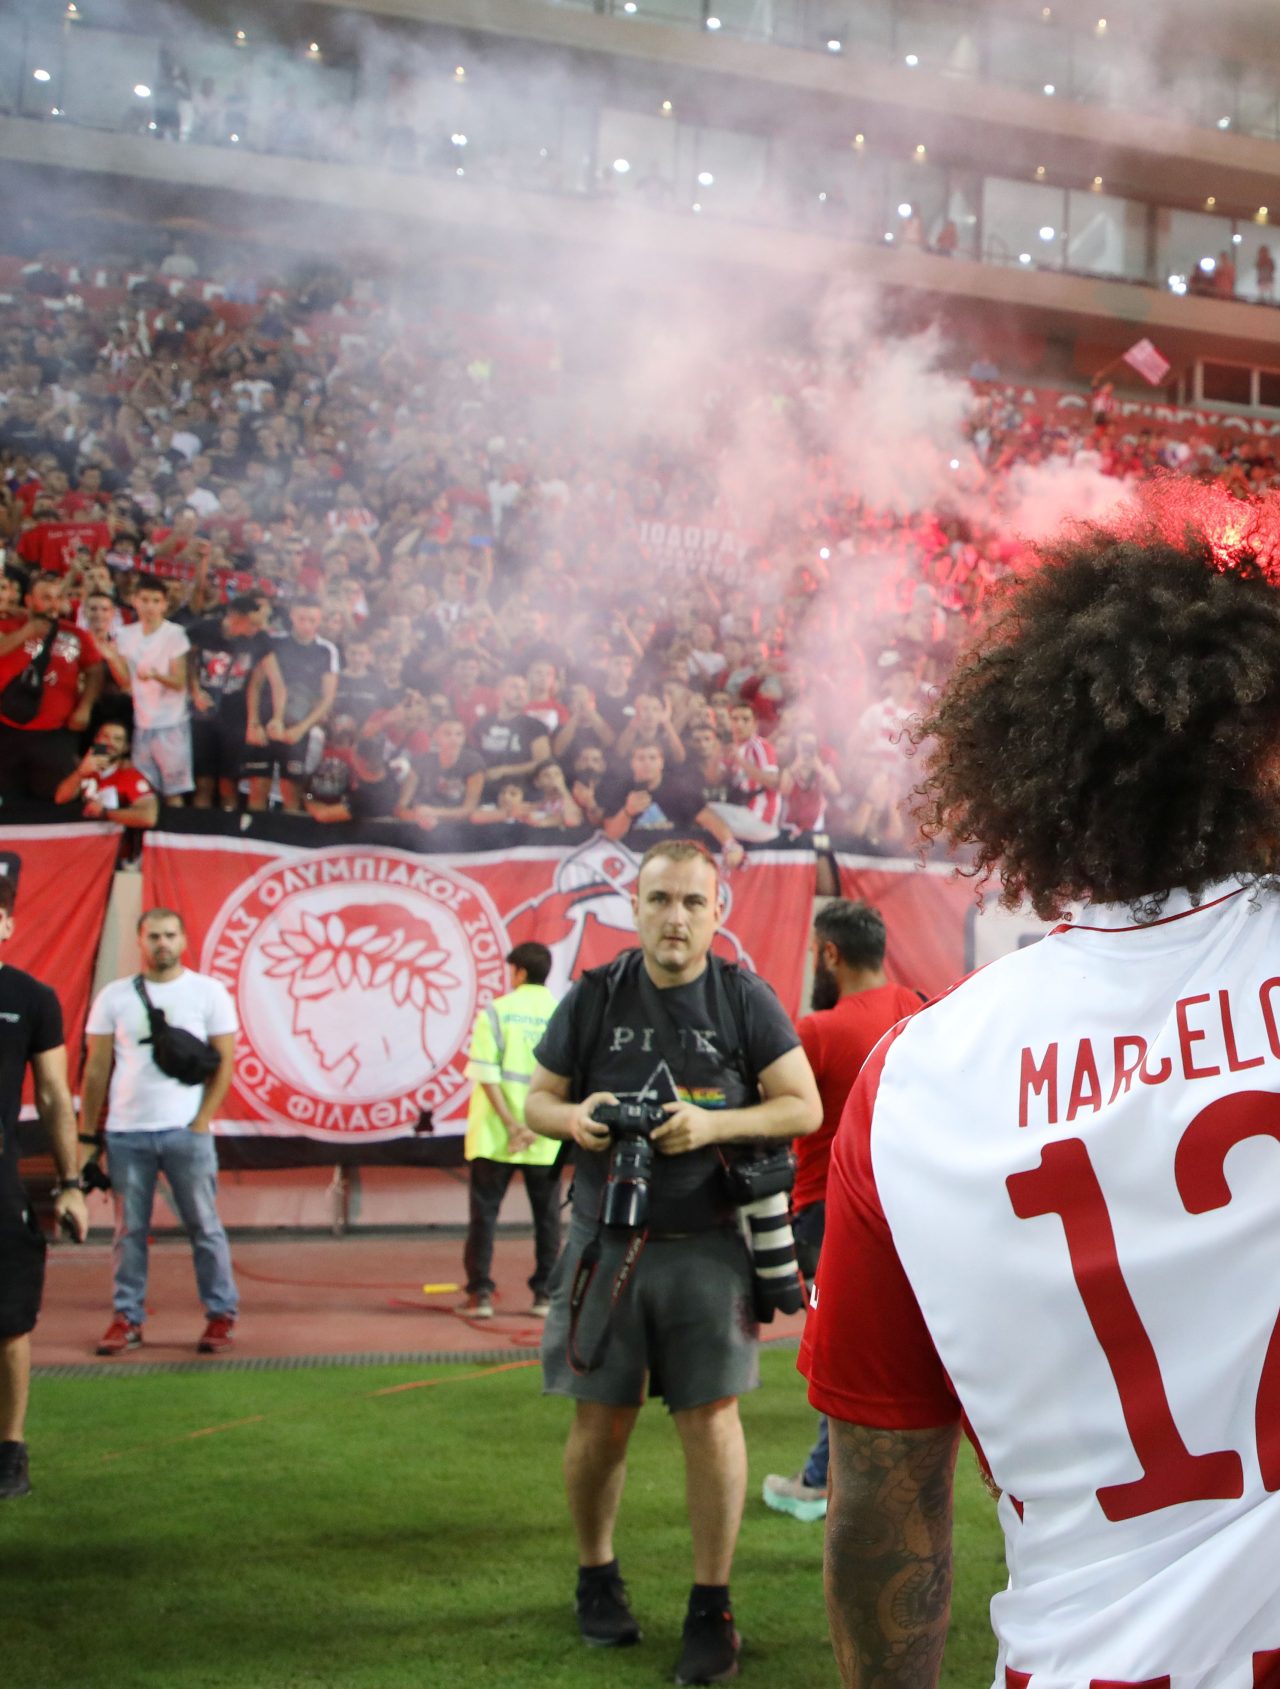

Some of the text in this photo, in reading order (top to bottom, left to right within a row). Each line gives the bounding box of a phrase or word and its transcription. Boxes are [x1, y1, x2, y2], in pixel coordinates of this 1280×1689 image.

[258, 857, 472, 909] ΟΛΥΜΠΙΑΚΟΣ
[211, 905, 281, 1102] ΣΥΝΜΟΣ
[286, 1065, 466, 1131] ΦΙΛΑΘΛΩΝ
[609, 1026, 721, 1054] PIK
